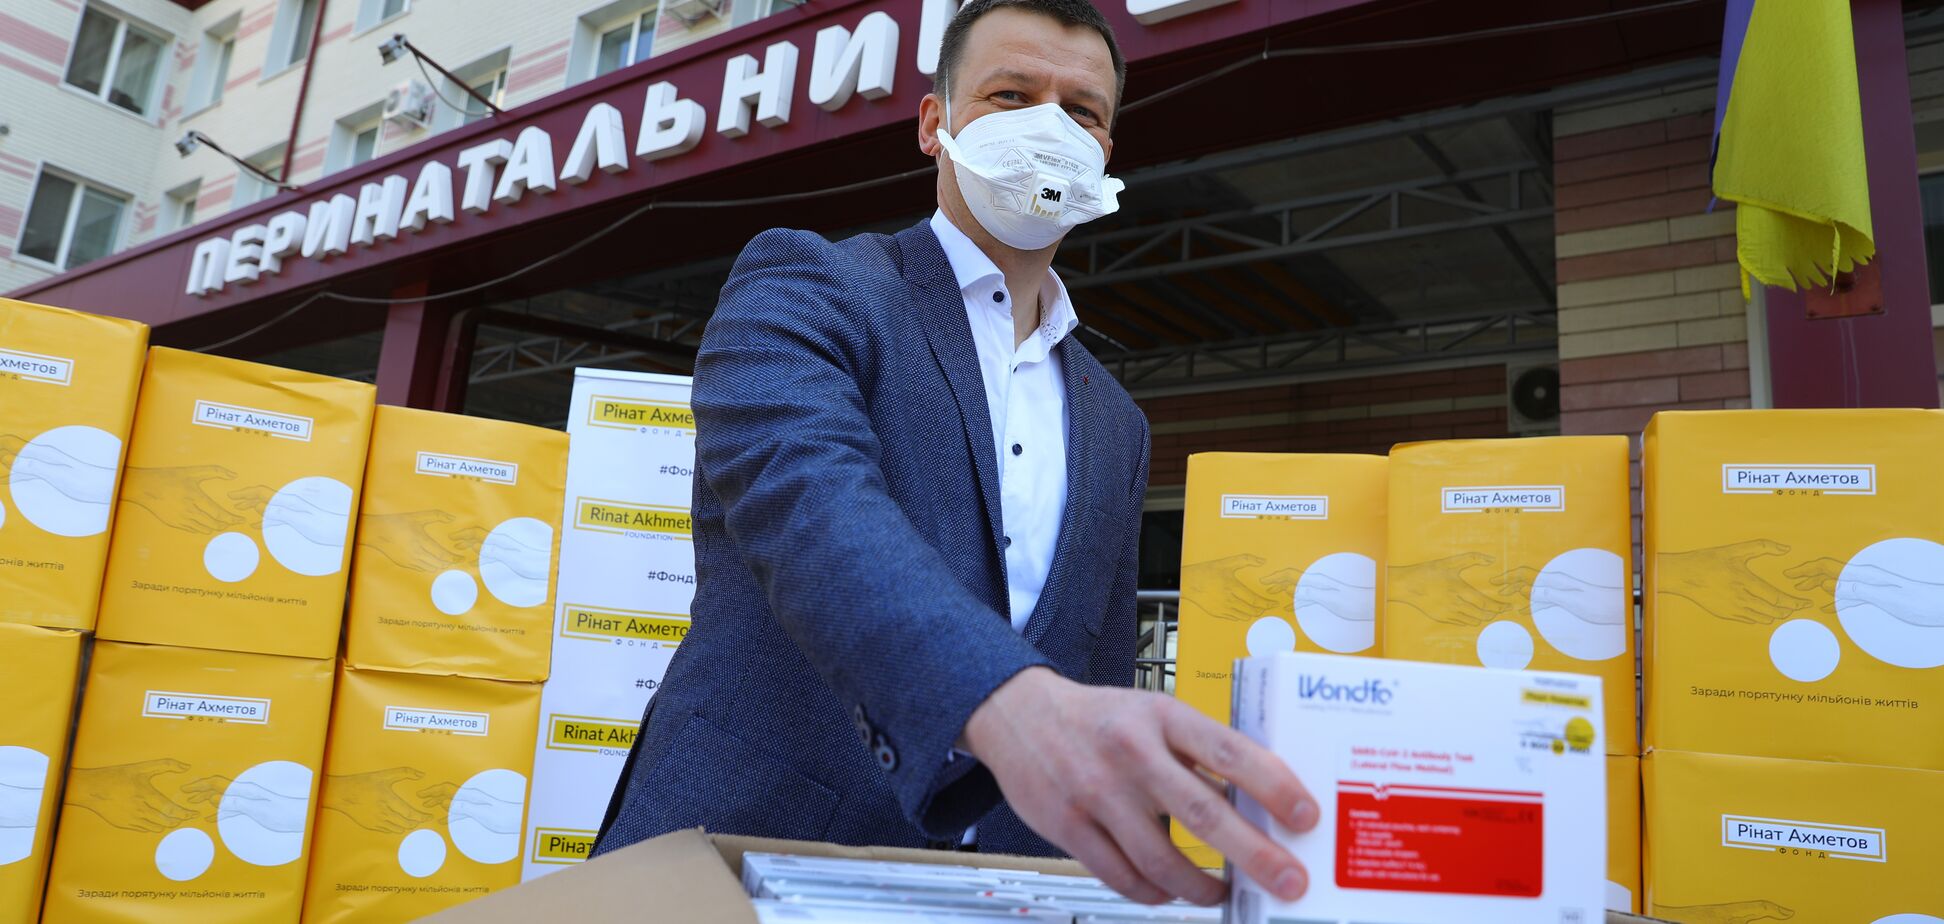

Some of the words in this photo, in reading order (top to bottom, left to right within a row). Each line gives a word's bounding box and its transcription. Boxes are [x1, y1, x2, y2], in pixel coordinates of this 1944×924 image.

[1041, 188, 1061, 202] 3M
[0, 357, 57, 375] хметов
[206, 407, 241, 422] Рінат
[244, 413, 300, 432] Ахметов
[603, 403, 646, 420] Рінат
[650, 408, 693, 424] Ахме
[640, 427, 682, 437] ФОНД
[426, 457, 456, 470] Рінат
[459, 462, 507, 477] Ахметов
[659, 465, 695, 478] #Фон
[1737, 471, 1781, 484] Рінат
[1785, 472, 1859, 485] Ахметов
[1453, 492, 1489, 504] Рінат
[1491, 492, 1552, 504] Ахметов
[1776, 489, 1820, 497] ФОНД
[1231, 500, 1262, 511] Рінат
[1265, 501, 1317, 512] Ахметов
[590, 507, 629, 525] Rinat
[632, 512, 691, 530] Akhmet
[625, 531, 673, 541] FOUNDATION
[647, 570, 697, 584] #Фонд
[131, 580, 170, 592] Заради
[172, 585, 224, 599] порятунку
[577, 613, 621, 631] Рінат
[625, 618, 689, 637] Ахмето
[615, 638, 659, 649] ФОНД
[1690, 686, 1735, 698] Заради
[1738, 689, 1804, 704] порятунку
[1807, 693, 1872, 706] мільйонів
[1875, 698, 1919, 710] життів
[157, 697, 194, 711] Рінат
[197, 700, 257, 715] Ахметов
[395, 711, 425, 724] Рінат
[428, 714, 478, 729] Ахметов
[563, 724, 603, 742] Rinat
[607, 730, 638, 744] Akh
[599, 748, 630, 757] FOUND
[1738, 823, 1783, 841] Рінат
[1788, 828, 1868, 849] Ахметов
[549, 836, 595, 855] Рінат
[1779, 847, 1826, 859] ФОНД
[77, 889, 119, 899] Заради
[122, 889, 178, 900] порятунку
[180, 889, 231, 899] мільйонів
[233, 891, 266, 899] життів
[335, 883, 369, 892] Заради
[371, 884, 417, 894] порятунку
